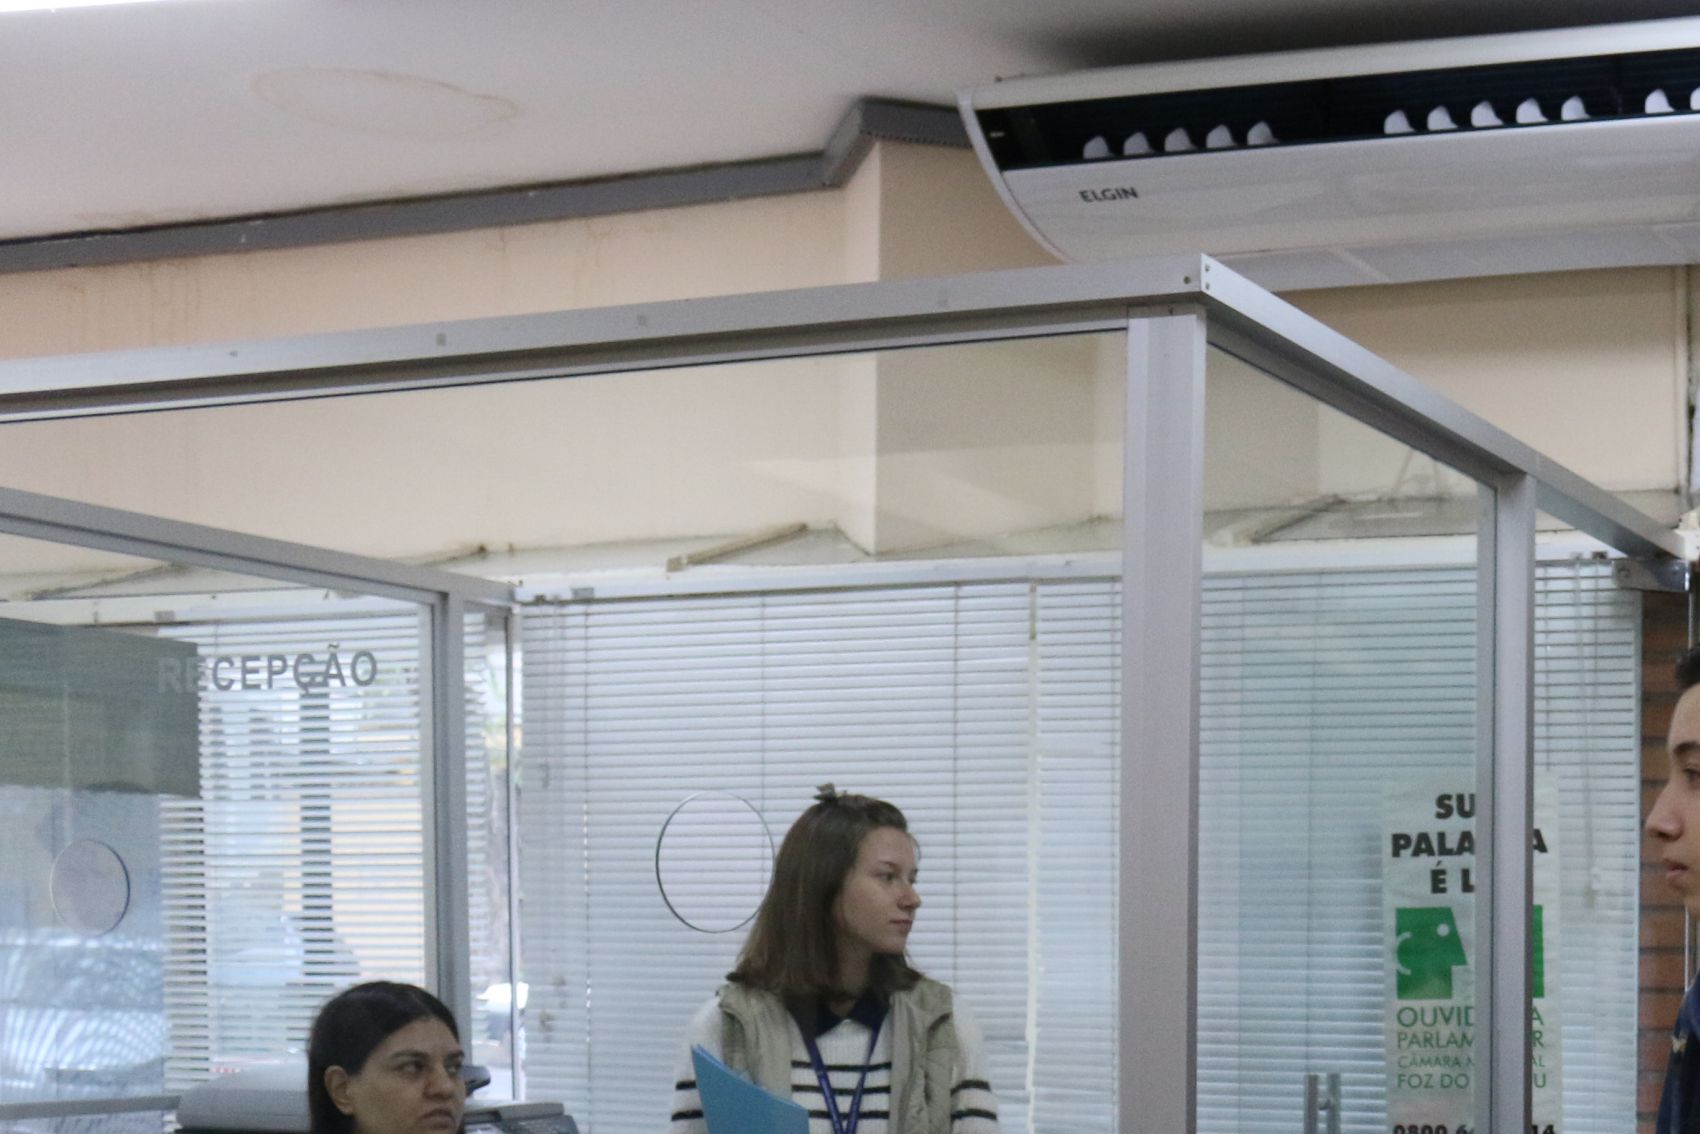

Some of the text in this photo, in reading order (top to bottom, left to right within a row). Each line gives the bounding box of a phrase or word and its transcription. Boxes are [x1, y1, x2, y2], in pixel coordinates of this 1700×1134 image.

[1079, 187, 1138, 203] ELGIN
[157, 642, 378, 695] RECEPÇÃO
[1435, 793, 1475, 819] SU
[1391, 829, 1548, 858] PALAA
[1397, 1073, 1469, 1089] FOZ DO
